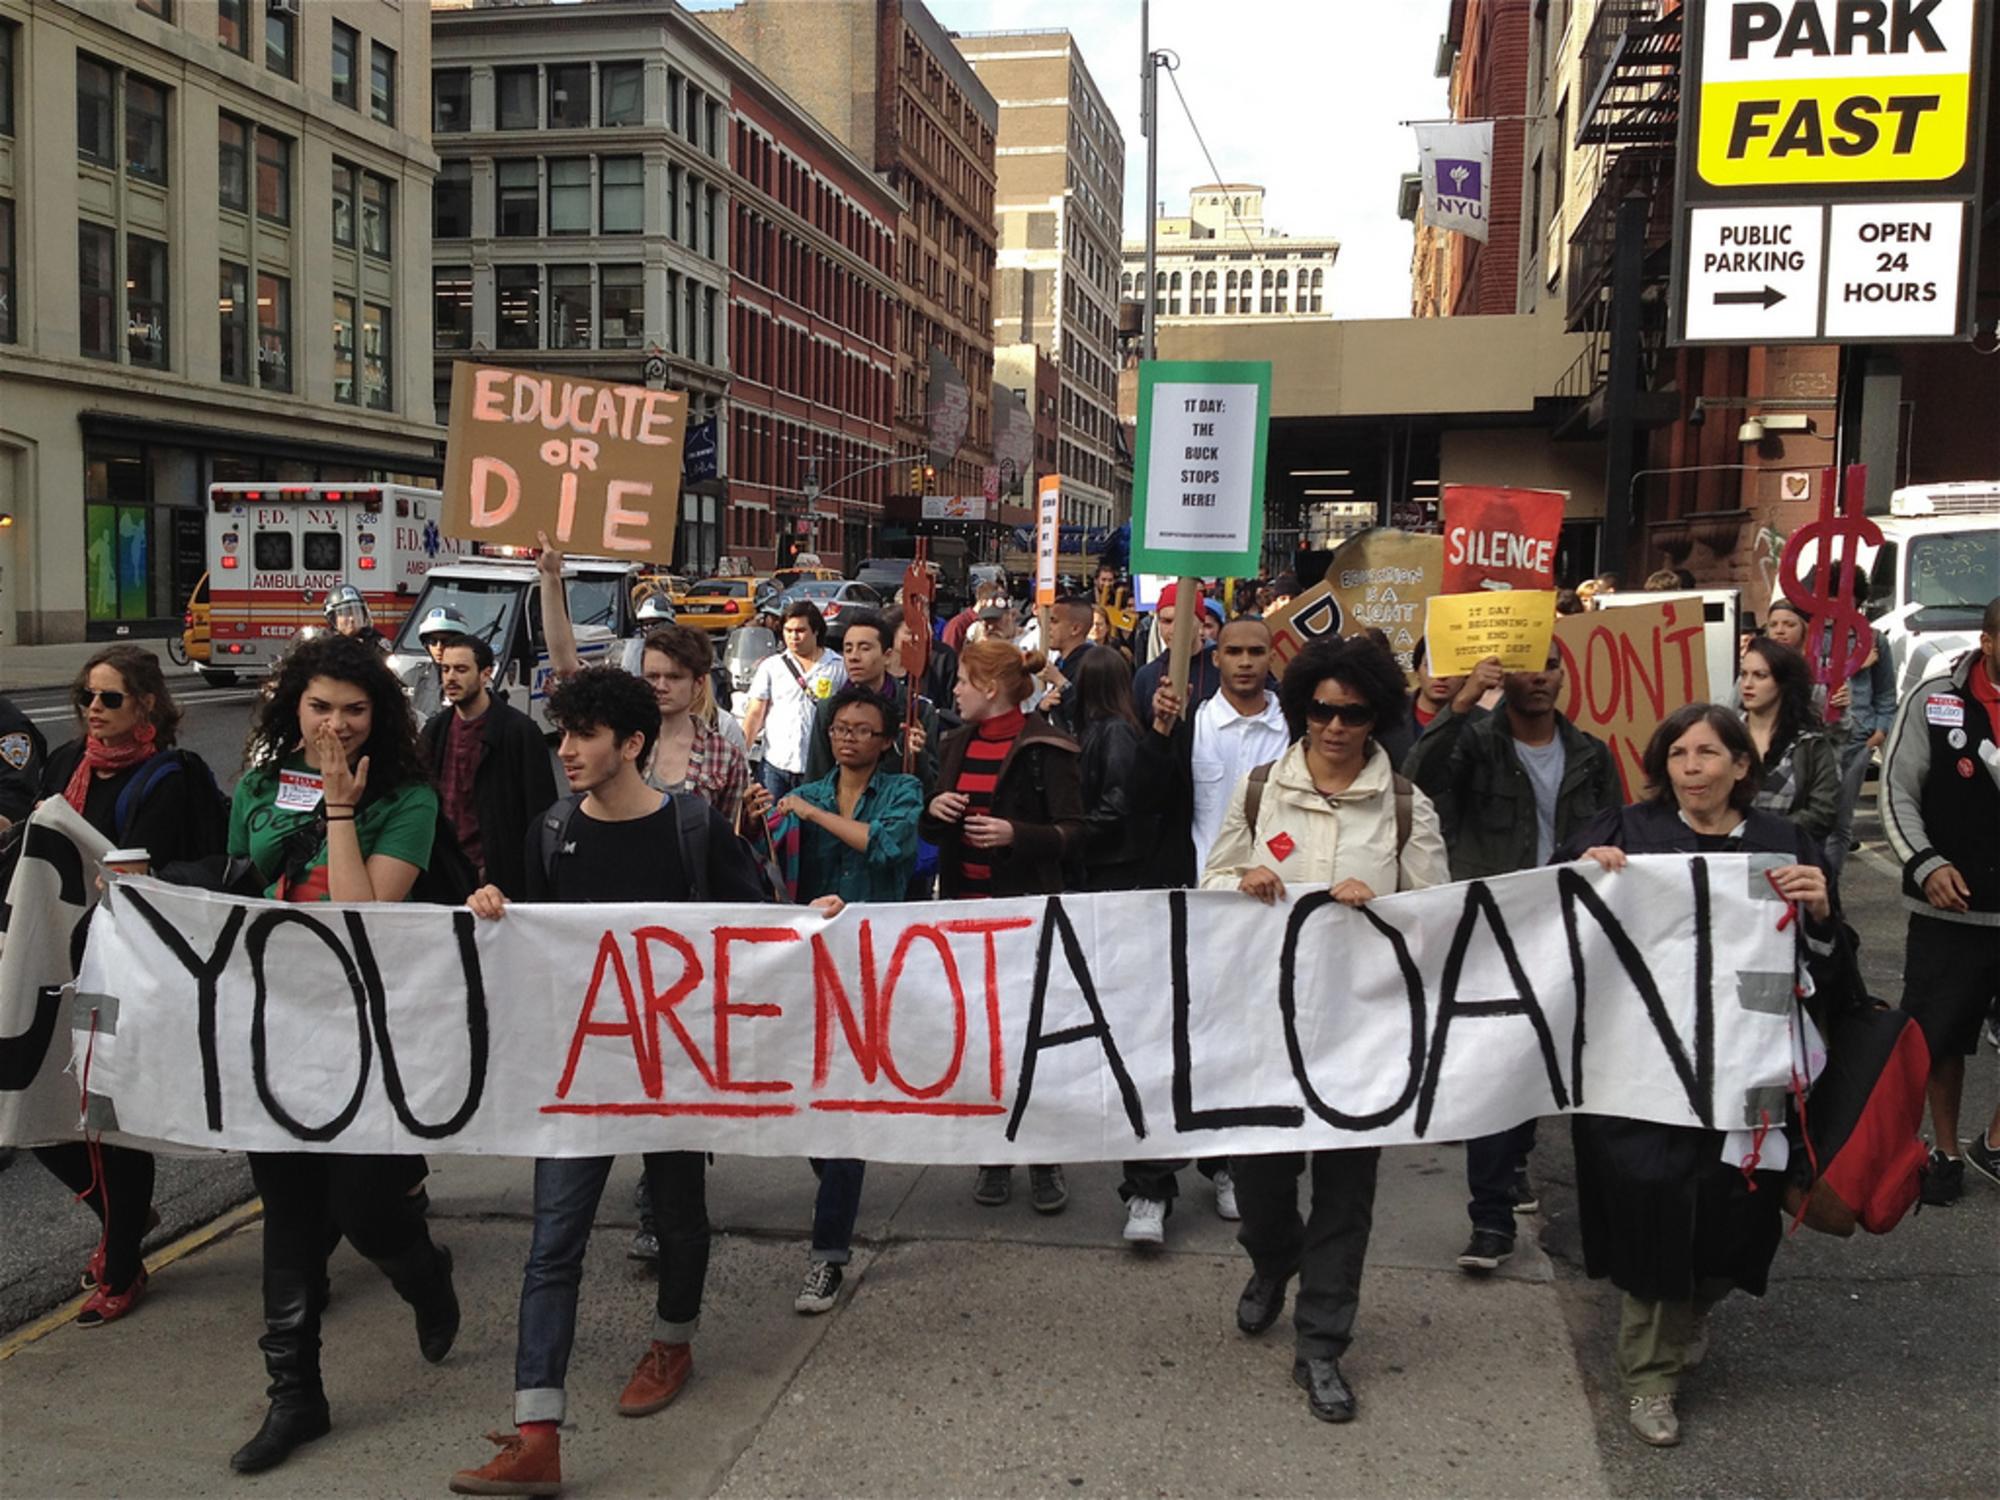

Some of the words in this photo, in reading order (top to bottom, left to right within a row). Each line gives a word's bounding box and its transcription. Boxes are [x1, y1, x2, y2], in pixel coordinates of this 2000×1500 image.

[1729, 0, 1948, 60] PARK
[1726, 95, 1941, 159] FAST
[1437, 197, 1481, 220] NYU
[1720, 225, 1792, 246] PUBLIC
[1858, 222, 1932, 243] OPEN
[1704, 251, 1805, 273] PARKING
[1876, 252, 1909, 272] 24
[1843, 282, 1938, 303] HOURS
[472, 369, 681, 446] EDUCATE
[1199, 399, 1226, 413] DAY:
[1193, 423, 1214, 437] THE
[539, 438, 599, 471] OR
[1185, 446, 1219, 460] BUCK
[1181, 470, 1220, 483] STOPS
[469, 455, 653, 551] DIE
[1181, 493, 1216, 507] HERE!
[257, 509, 289, 524] F.D.
[307, 509, 339, 525] N.Y.
[395, 527, 423, 551] F.D.
[1448, 526, 1553, 573] SILENCE
[252, 574, 343, 589] AMBULANCE
[260, 625, 296, 636] KEEP
[118, 883, 491, 1144] YOU
[556, 924, 803, 1100] ARE
[810, 917, 1037, 1100] NOT
[1005, 895, 1148, 1143] A
[1168, 855, 1716, 1139] LOAN
